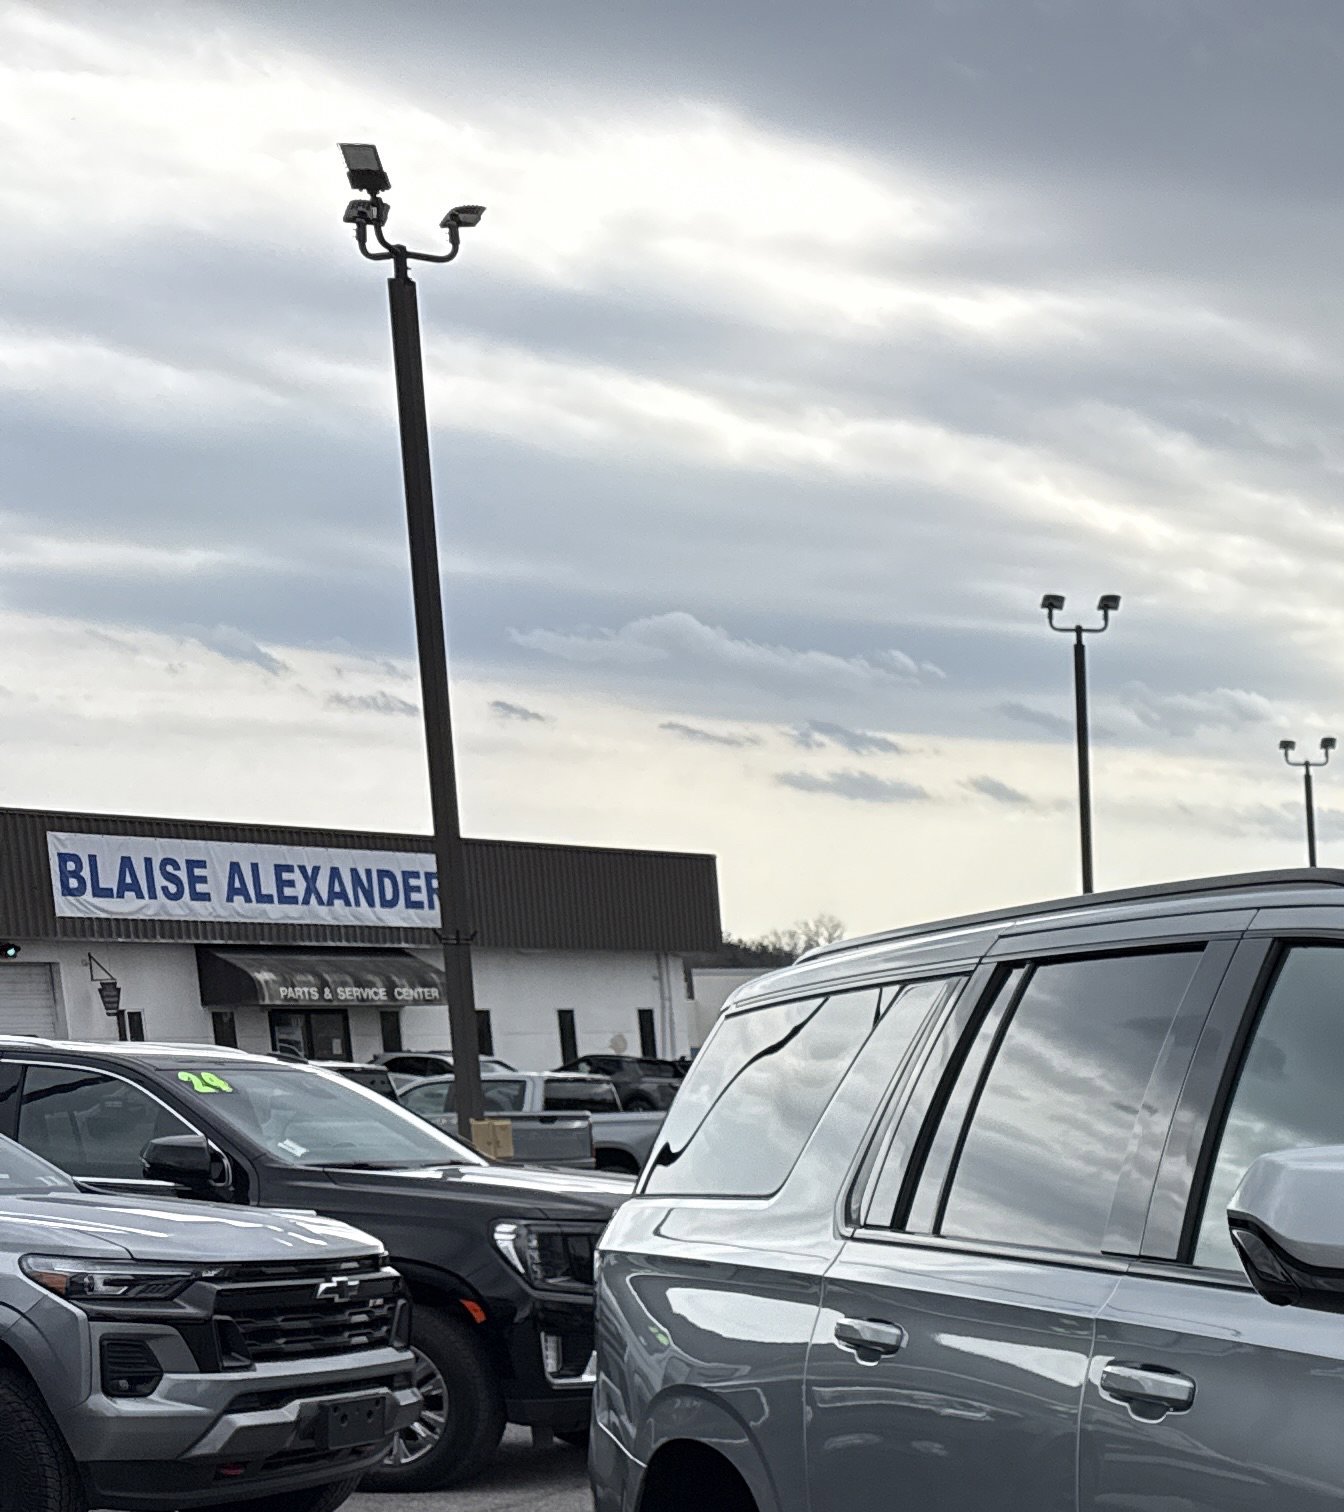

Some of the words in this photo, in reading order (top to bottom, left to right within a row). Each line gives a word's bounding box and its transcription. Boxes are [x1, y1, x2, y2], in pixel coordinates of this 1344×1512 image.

[56, 851, 211, 903] BLAISE
[280, 987, 319, 1000] PARTS
[324, 987, 333, 1000] &
[337, 987, 387, 1000] SERVICE
[394, 987, 439, 1001] CENTER
